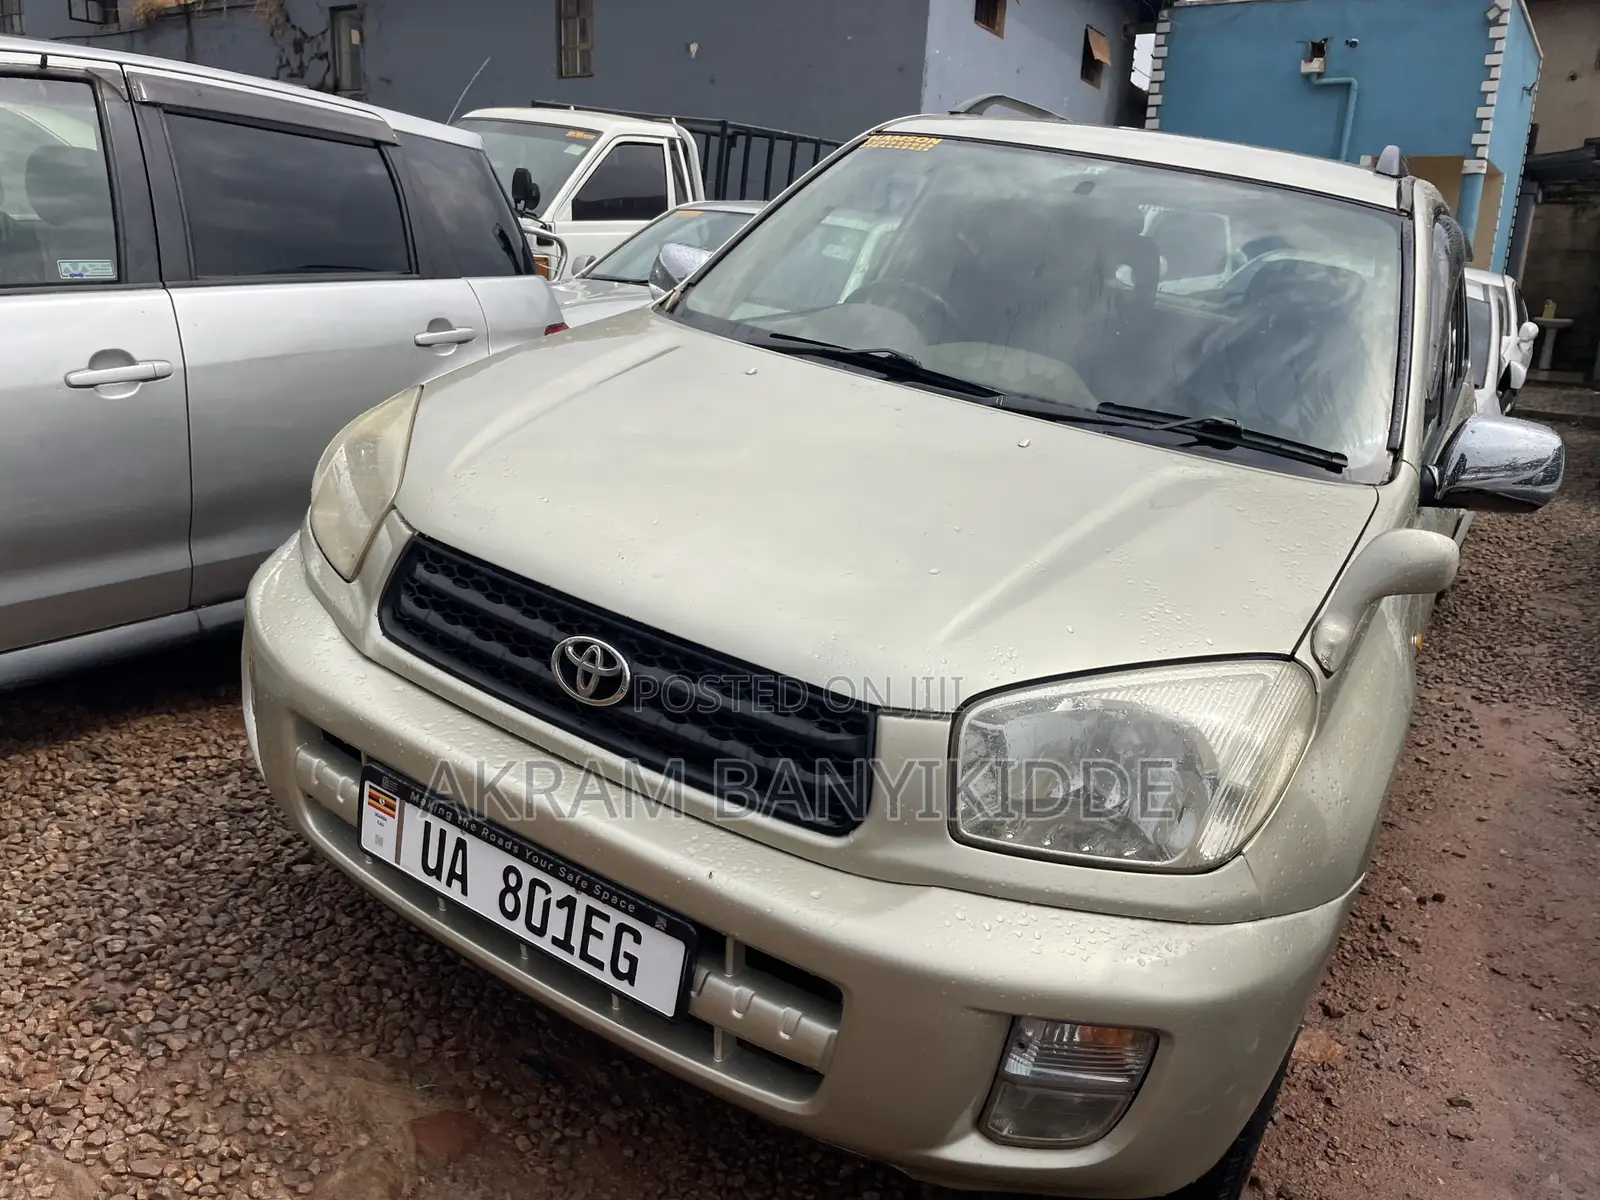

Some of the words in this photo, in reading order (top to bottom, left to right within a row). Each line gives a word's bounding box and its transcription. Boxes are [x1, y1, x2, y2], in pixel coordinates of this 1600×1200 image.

[410, 791, 453, 820] Making
[457, 814, 476, 832] the
[481, 827, 520, 854] Roads
[525, 849, 553, 870] Your
[558, 866, 588, 889] Safe
[593, 884, 636, 913] Space
[421, 819, 469, 897] UA
[498, 864, 643, 987] 801EG
